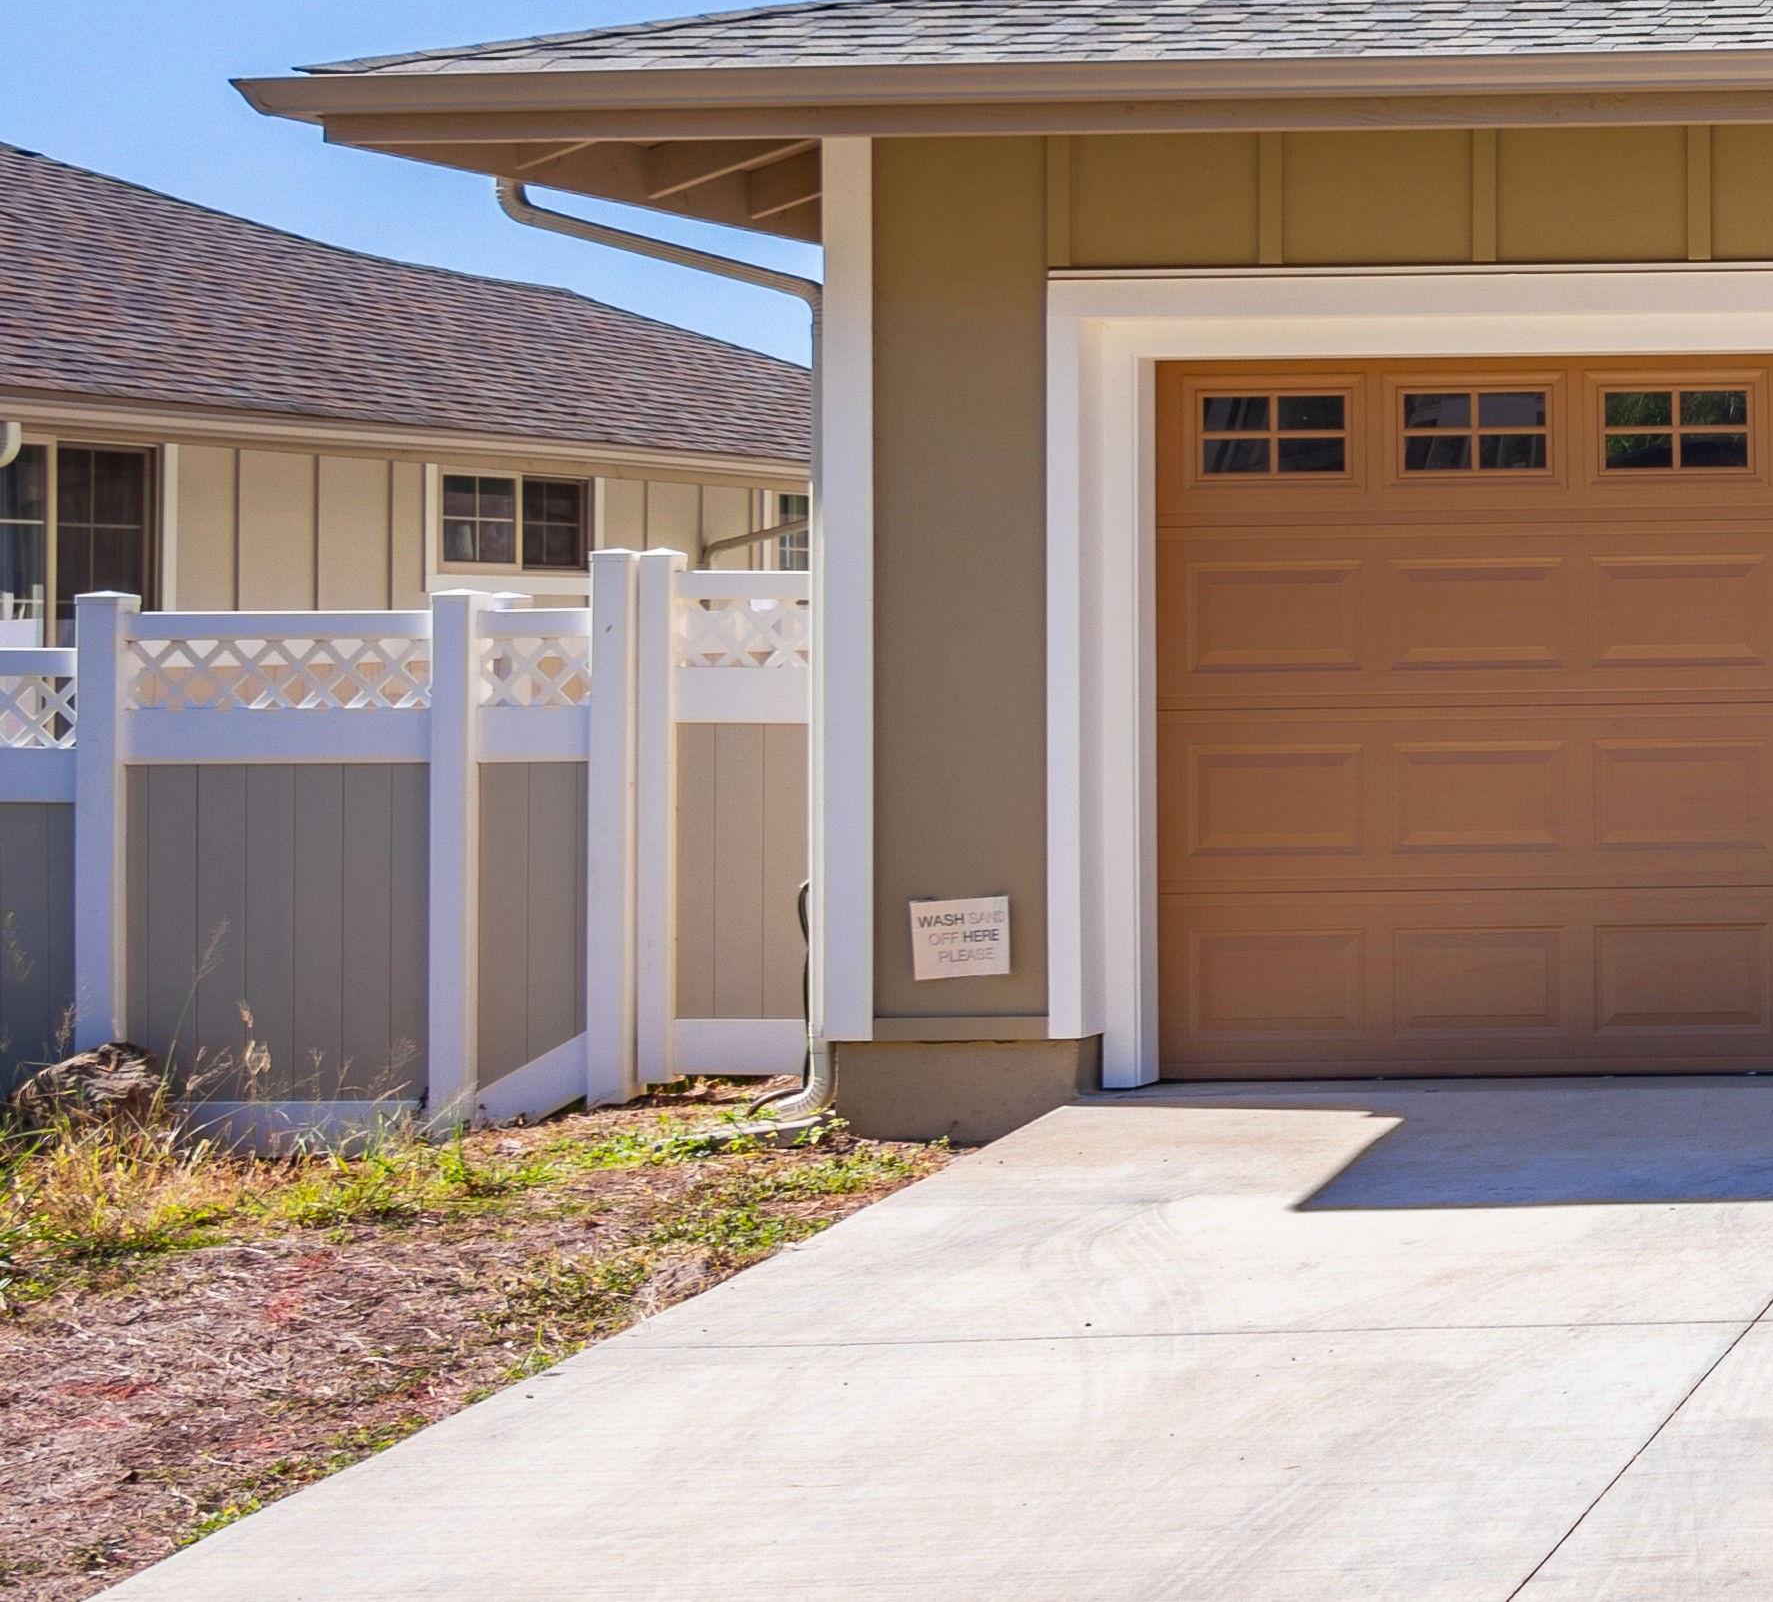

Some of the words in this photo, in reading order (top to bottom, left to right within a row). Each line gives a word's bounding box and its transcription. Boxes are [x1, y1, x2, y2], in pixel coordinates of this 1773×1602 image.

[918, 913, 965, 928] WASH
[969, 910, 1005, 923] SAND
[929, 932, 959, 946] OFF
[963, 929, 999, 943] HERE
[939, 947, 994, 962] PLEASE
